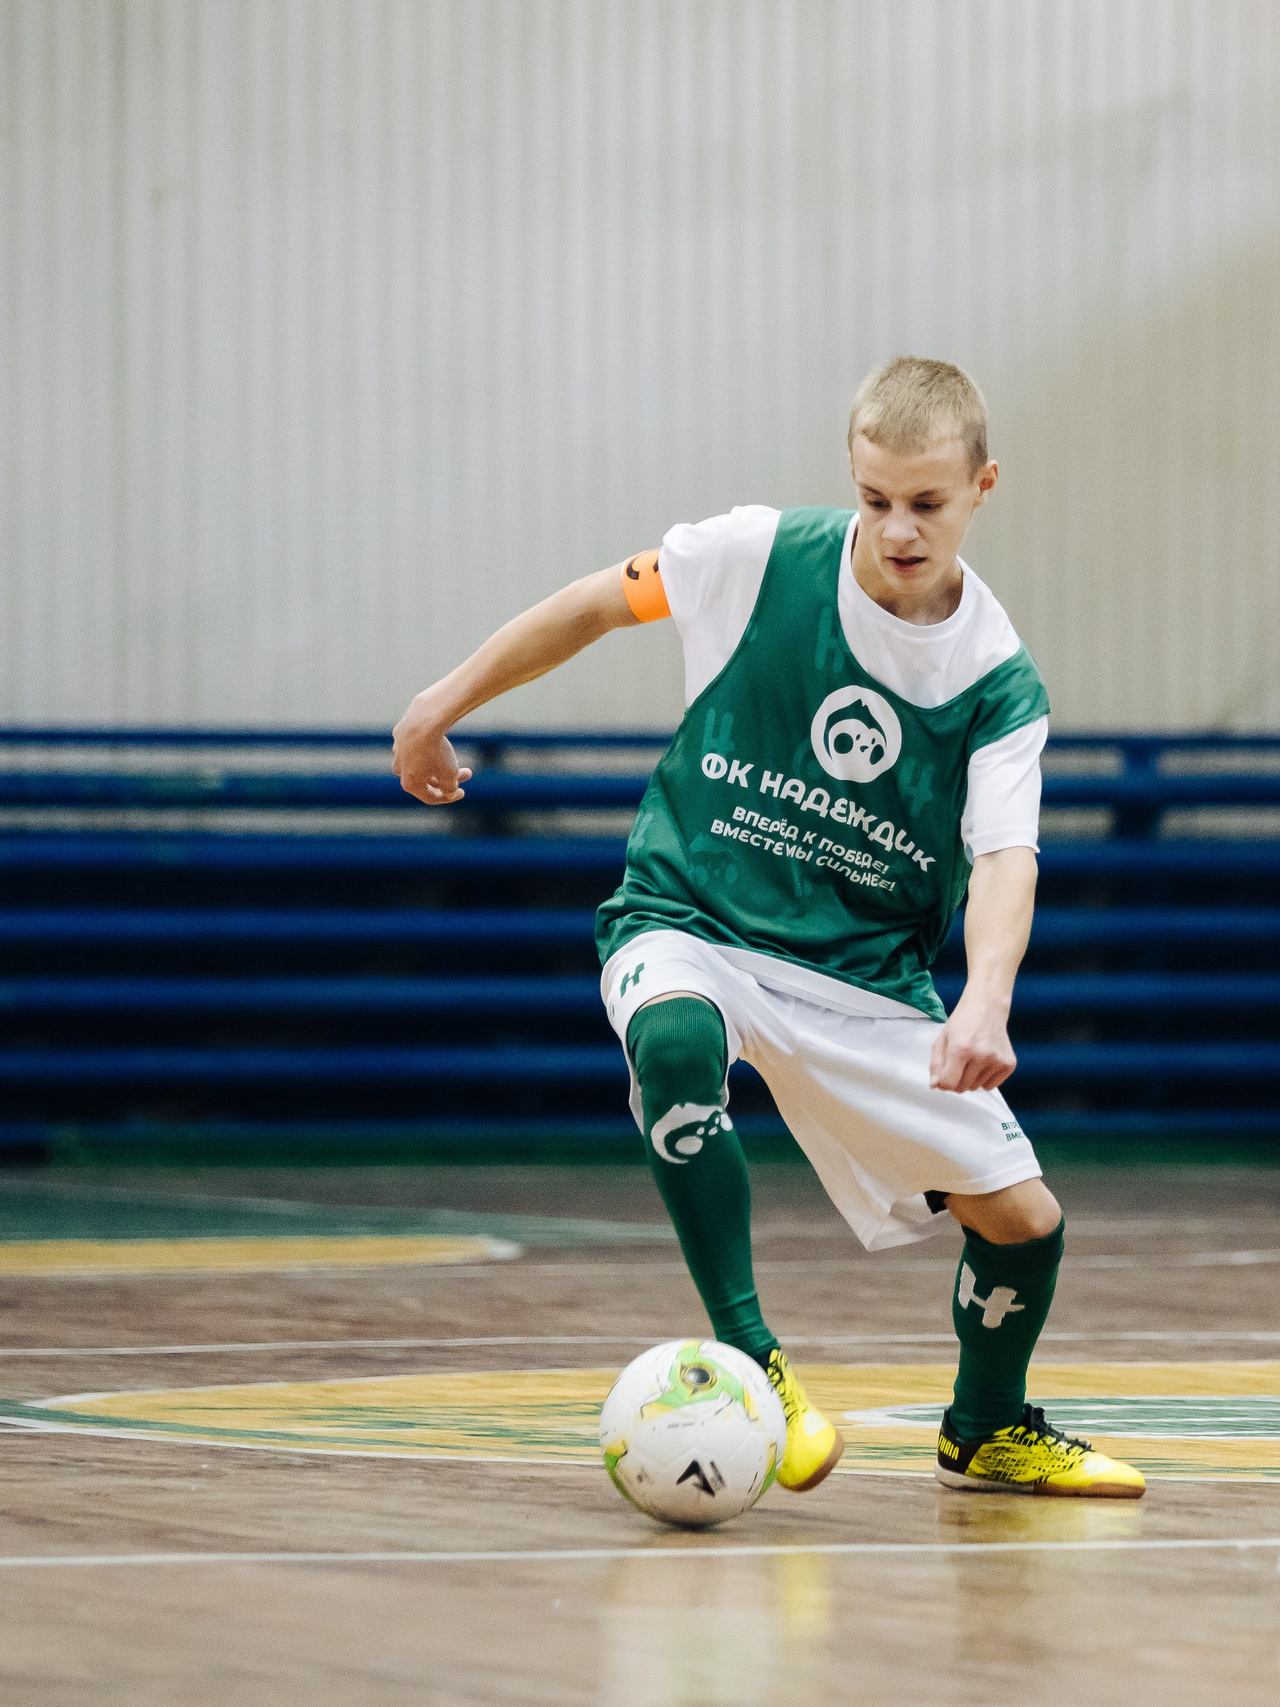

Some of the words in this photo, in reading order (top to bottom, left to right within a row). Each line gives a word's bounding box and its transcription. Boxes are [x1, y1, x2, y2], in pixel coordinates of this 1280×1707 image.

[701, 752, 754, 788] ФК
[759, 769, 936, 873] НАДЕЖДИК
[732, 806, 799, 841] ВПЕРЁД
[802, 830, 817, 844] К
[818, 837, 890, 875] ПОБЕДЕ!
[815, 855, 896, 892] СИЛЬНЕЕ!
